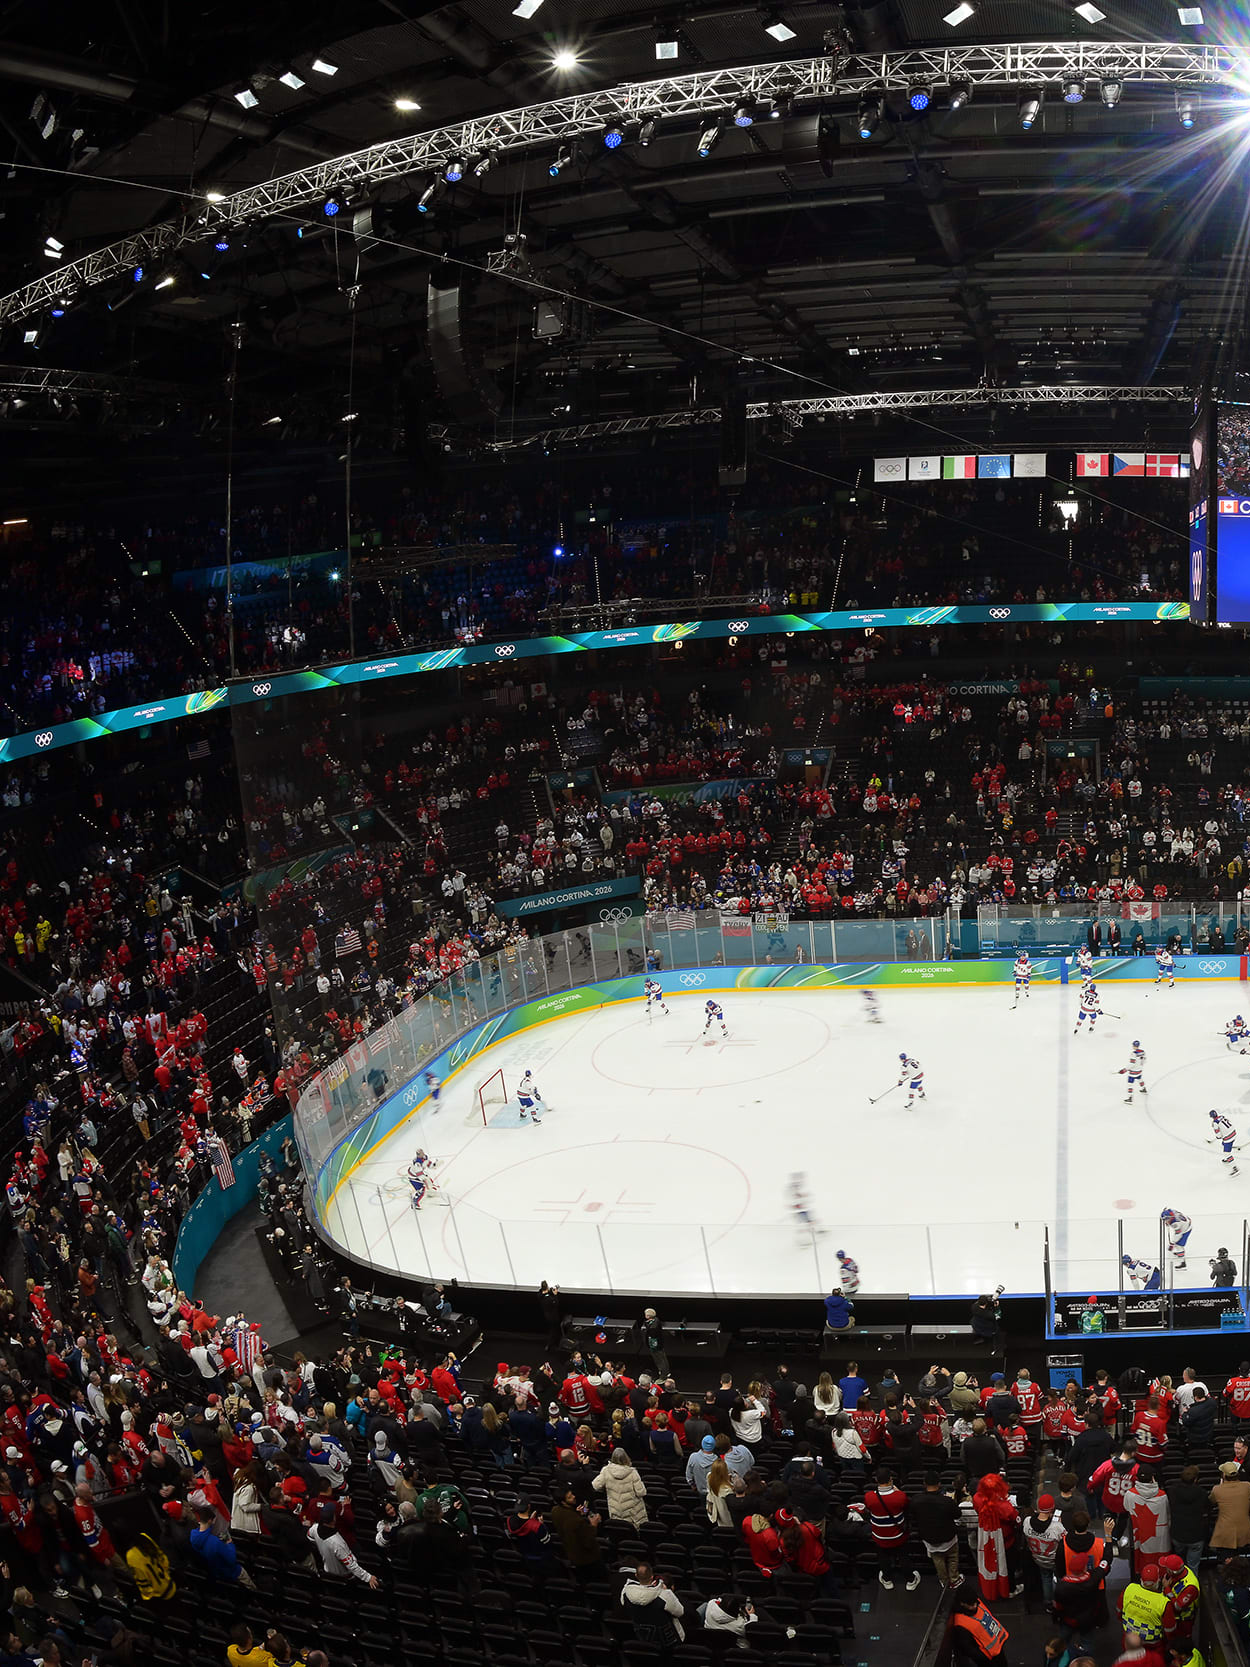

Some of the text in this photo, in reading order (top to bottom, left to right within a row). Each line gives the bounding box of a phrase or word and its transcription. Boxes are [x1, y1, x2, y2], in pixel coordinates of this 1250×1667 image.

[960, 684, 1010, 695] CORTINA
[519, 885, 613, 911] MILANO CORTINA 2026
[1084, 995, 1095, 1006] 72
[571, 1388, 586, 1404] 12
[1017, 1393, 1035, 1411] 97
[1007, 1440, 1025, 1454] 26
[1108, 1477, 1132, 1496] 99
